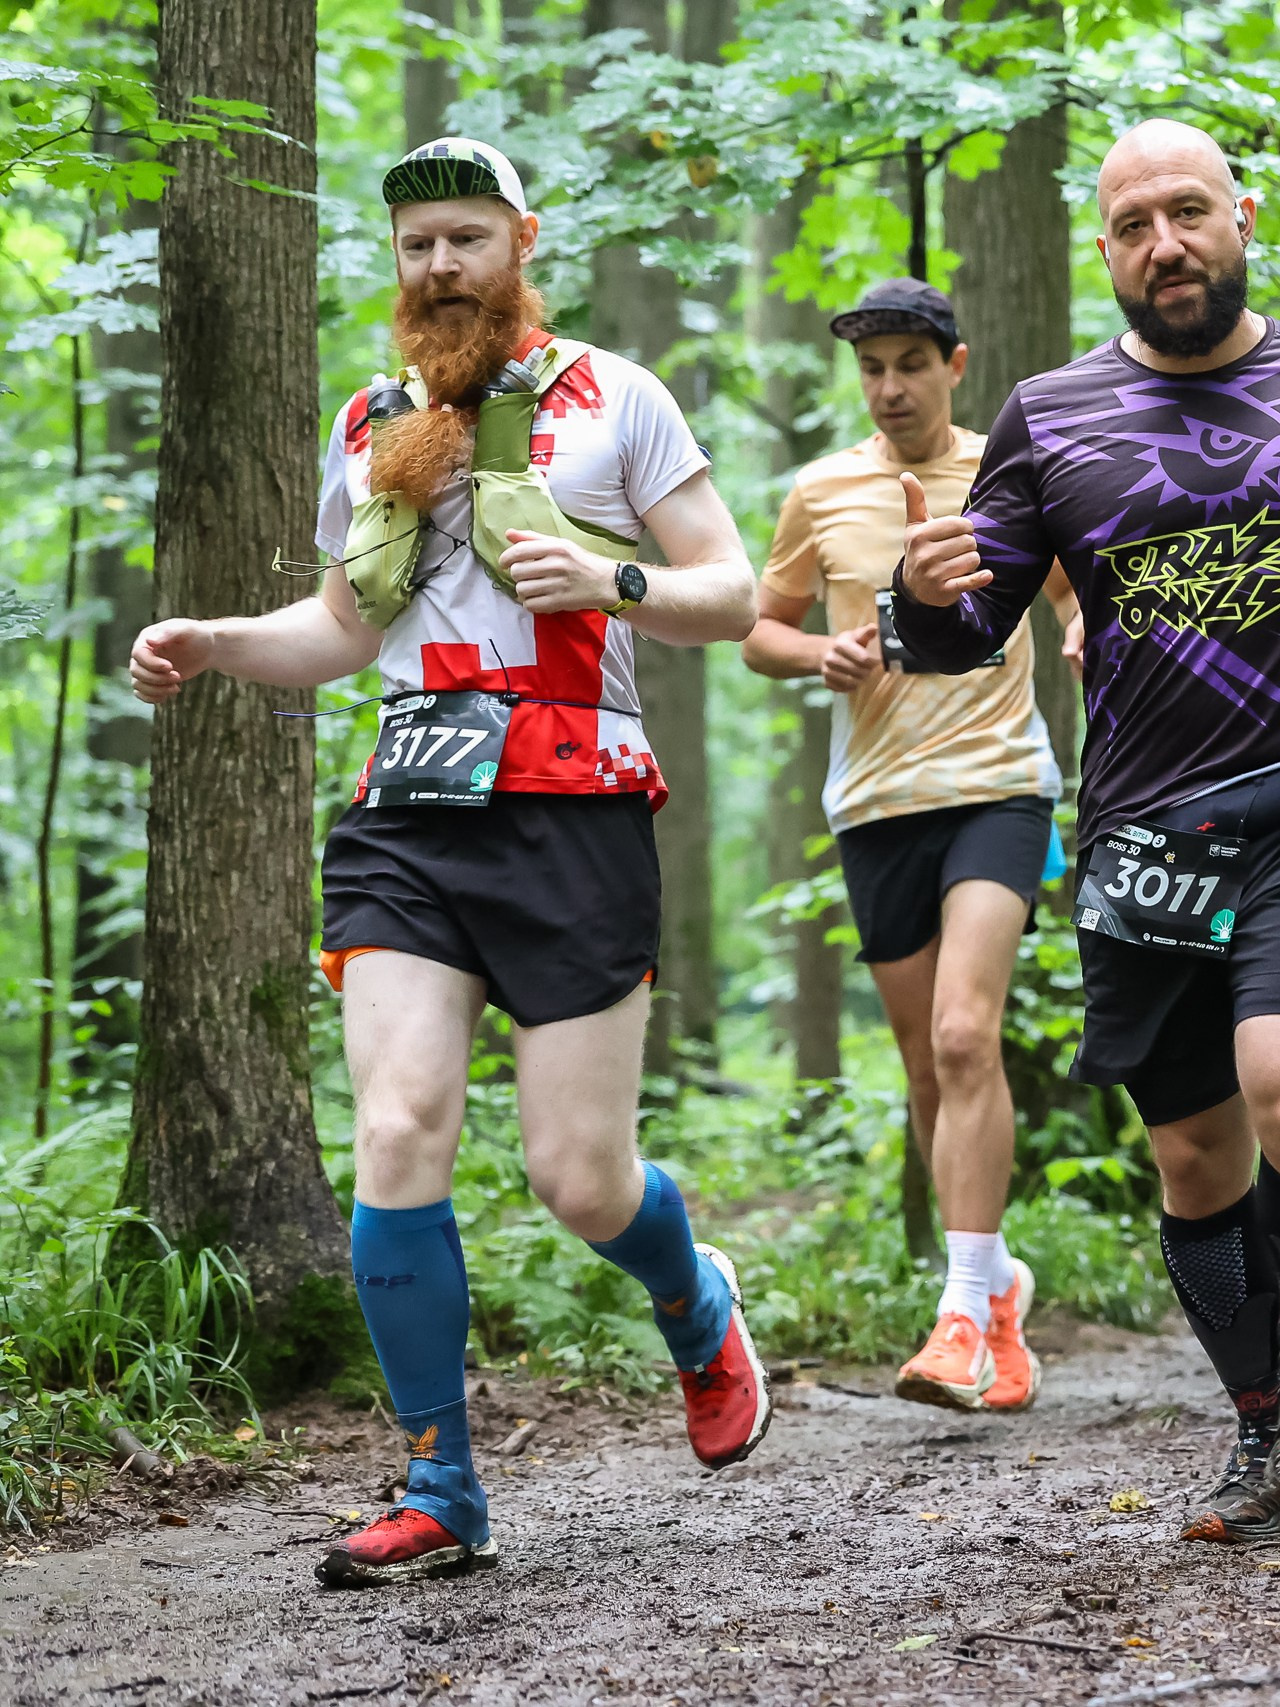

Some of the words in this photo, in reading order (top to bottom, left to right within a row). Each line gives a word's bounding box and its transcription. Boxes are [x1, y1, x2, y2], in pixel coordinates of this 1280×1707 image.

[381, 726, 490, 770] 3177
[1106, 839, 1128, 854] BOSS
[1127, 844, 1141, 857] 30
[1103, 856, 1221, 916] 3011
